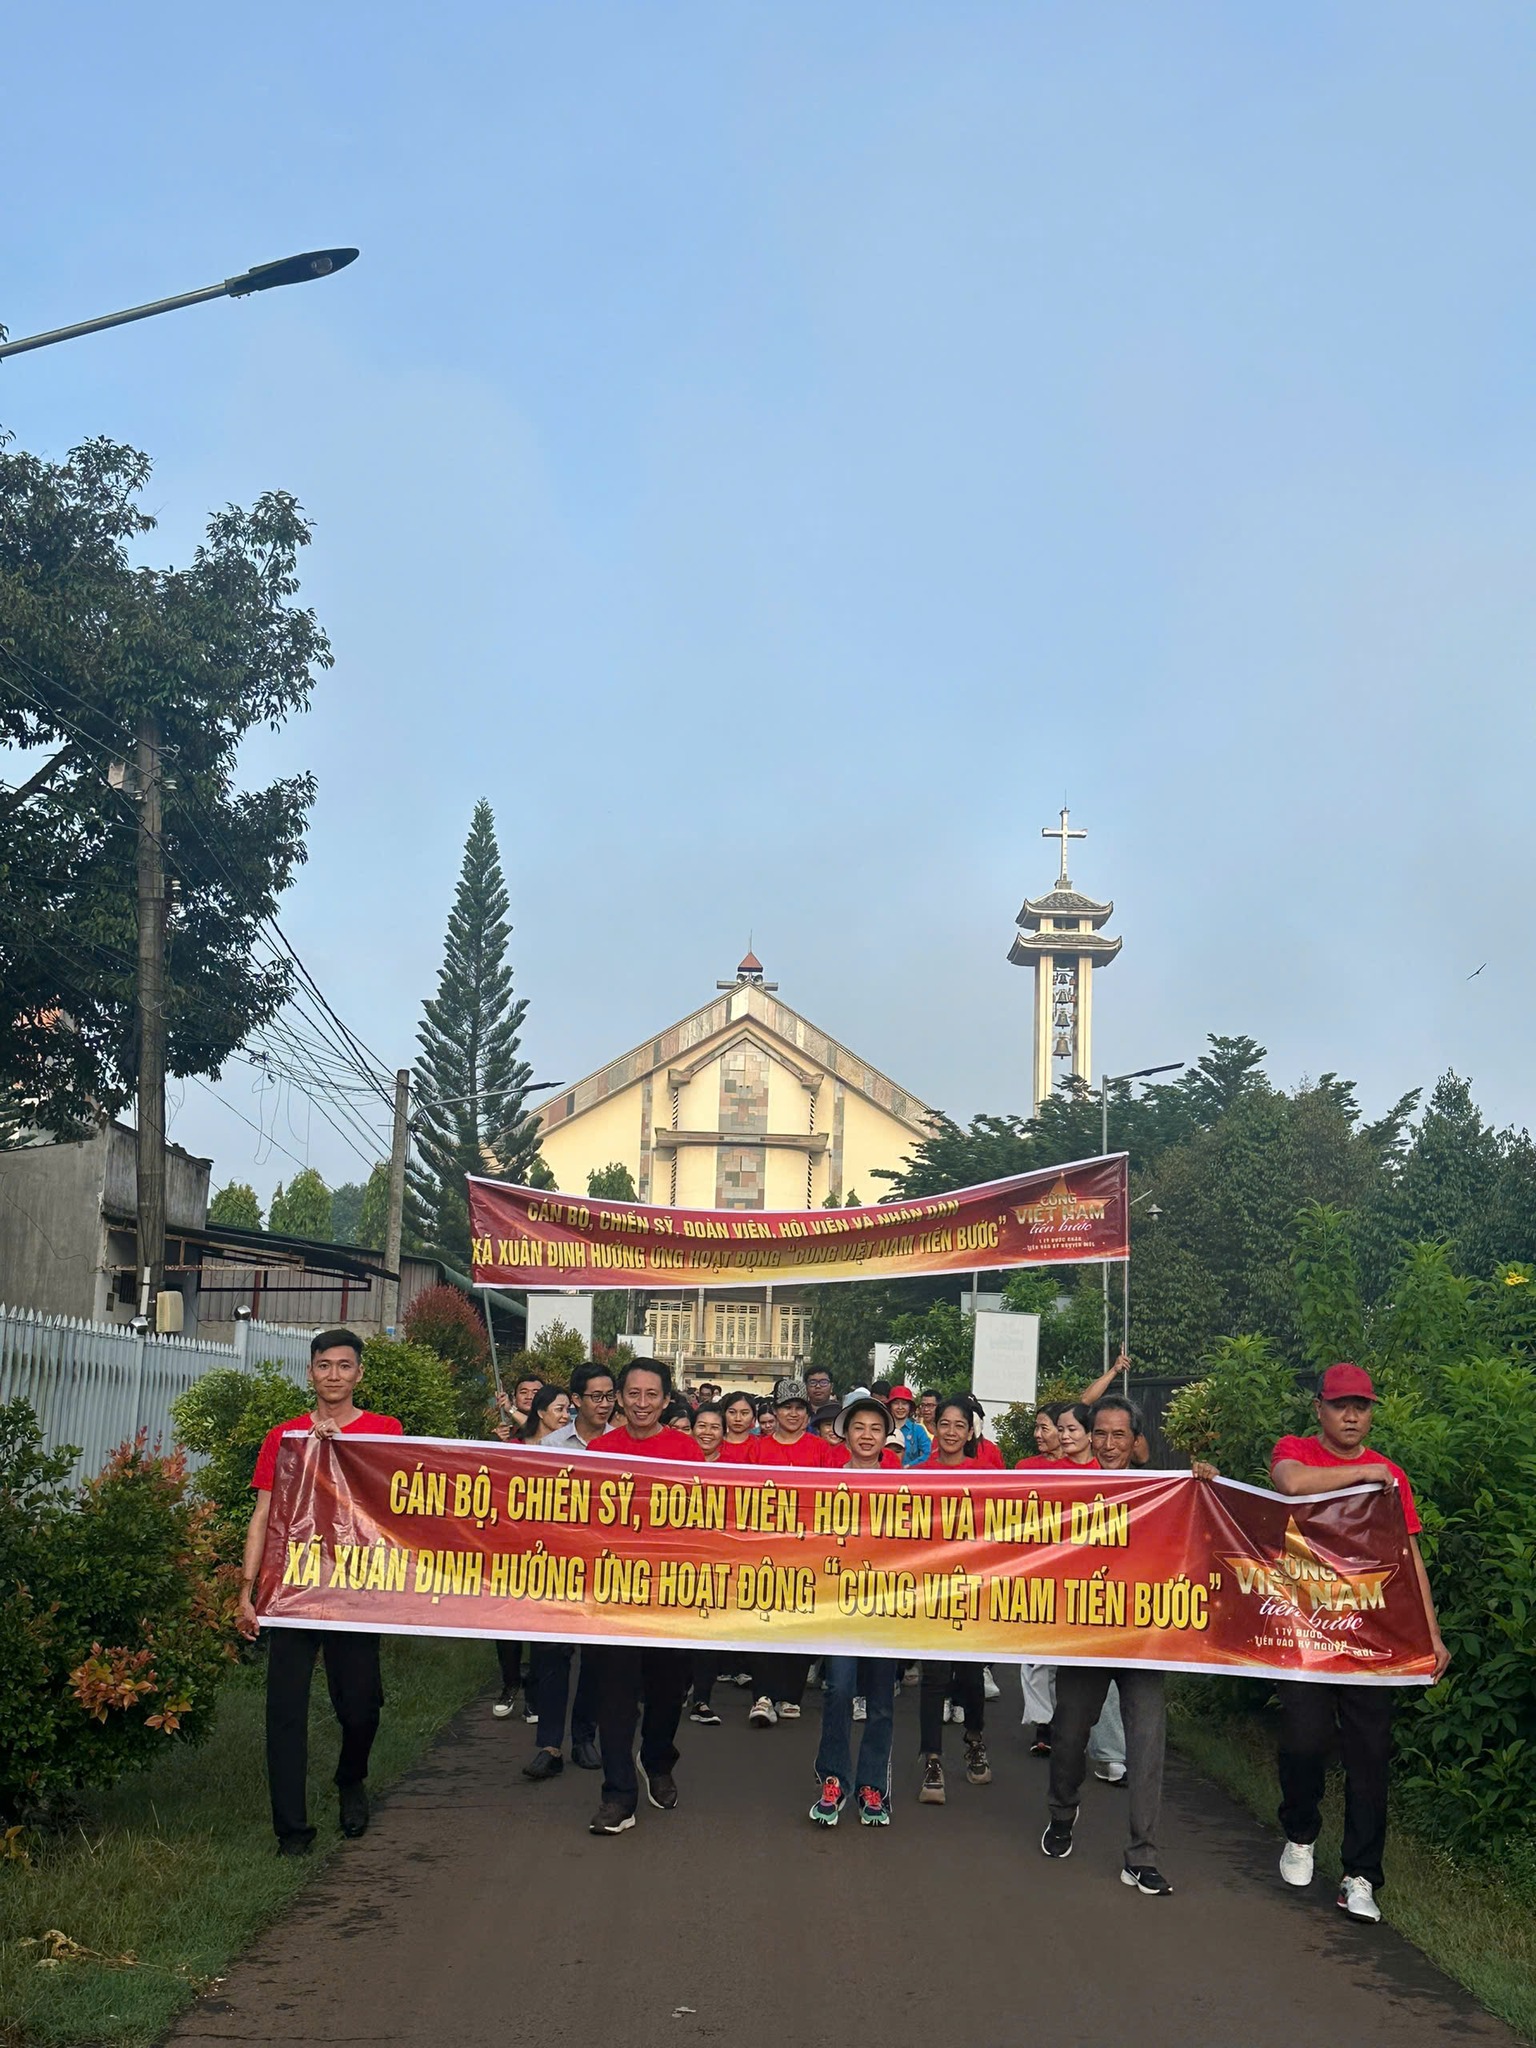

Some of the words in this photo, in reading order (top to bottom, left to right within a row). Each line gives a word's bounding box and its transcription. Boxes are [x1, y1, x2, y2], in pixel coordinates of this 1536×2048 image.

[1040, 1192, 1077, 1206] CÙNG
[1062, 1204, 1105, 1220] NAM
[527, 1198, 562, 1222] CÁN
[567, 1204, 594, 1231] BỘ,
[600, 1209, 649, 1234] CHIẾN
[683, 1218, 730, 1239] ĐOÀN
[810, 1217, 849, 1235] VIÊN
[851, 1213, 875, 1230] VÀ
[876, 1208, 923, 1226] NHÂN
[1029, 1220, 1054, 1234] tiến
[1058, 1217, 1093, 1232] bước
[471, 1234, 493, 1265] XÃ
[498, 1235, 543, 1267] XUÂN
[547, 1242, 587, 1273] ĐỊNH
[590, 1239, 646, 1269] HƯỞNG
[651, 1245, 685, 1269] ỨNG
[689, 1251, 731, 1274] HOẠT
[842, 1239, 875, 1265] VIỆT
[879, 1234, 915, 1257] NAM
[919, 1224, 953, 1254] TIẾN
[390, 1462, 447, 1517] CÁN
[454, 1465, 498, 1530] BỘ,
[507, 1464, 590, 1524] CHIẾN
[598, 1472, 641, 1532] SỸ,
[650, 1475, 727, 1531] ĐOÀN
[735, 1479, 805, 1539] VIÊN,
[814, 1482, 860, 1547] HỘI
[869, 1485, 932, 1540] VIÊN
[940, 1487, 977, 1542] VÀ
[984, 1489, 1063, 1545] NHÂN
[1071, 1492, 1129, 1549] DÂN
[282, 1534, 323, 1588] XÃ
[329, 1537, 411, 1592] XUÂN
[414, 1549, 484, 1604] ĐỊNH
[490, 1540, 586, 1602] HƯỞNG
[593, 1548, 651, 1605] ỨNG
[658, 1560, 731, 1619] HOẠT
[736, 1556, 816, 1622] ĐỘNG
[924, 1564, 983, 1630] VIỆT
[988, 1574, 1056, 1624] NAM
[1064, 1564, 1127, 1627] TIẾN
[1309, 1581, 1386, 1611] NAM
[1309, 1605, 1364, 1631] bước
